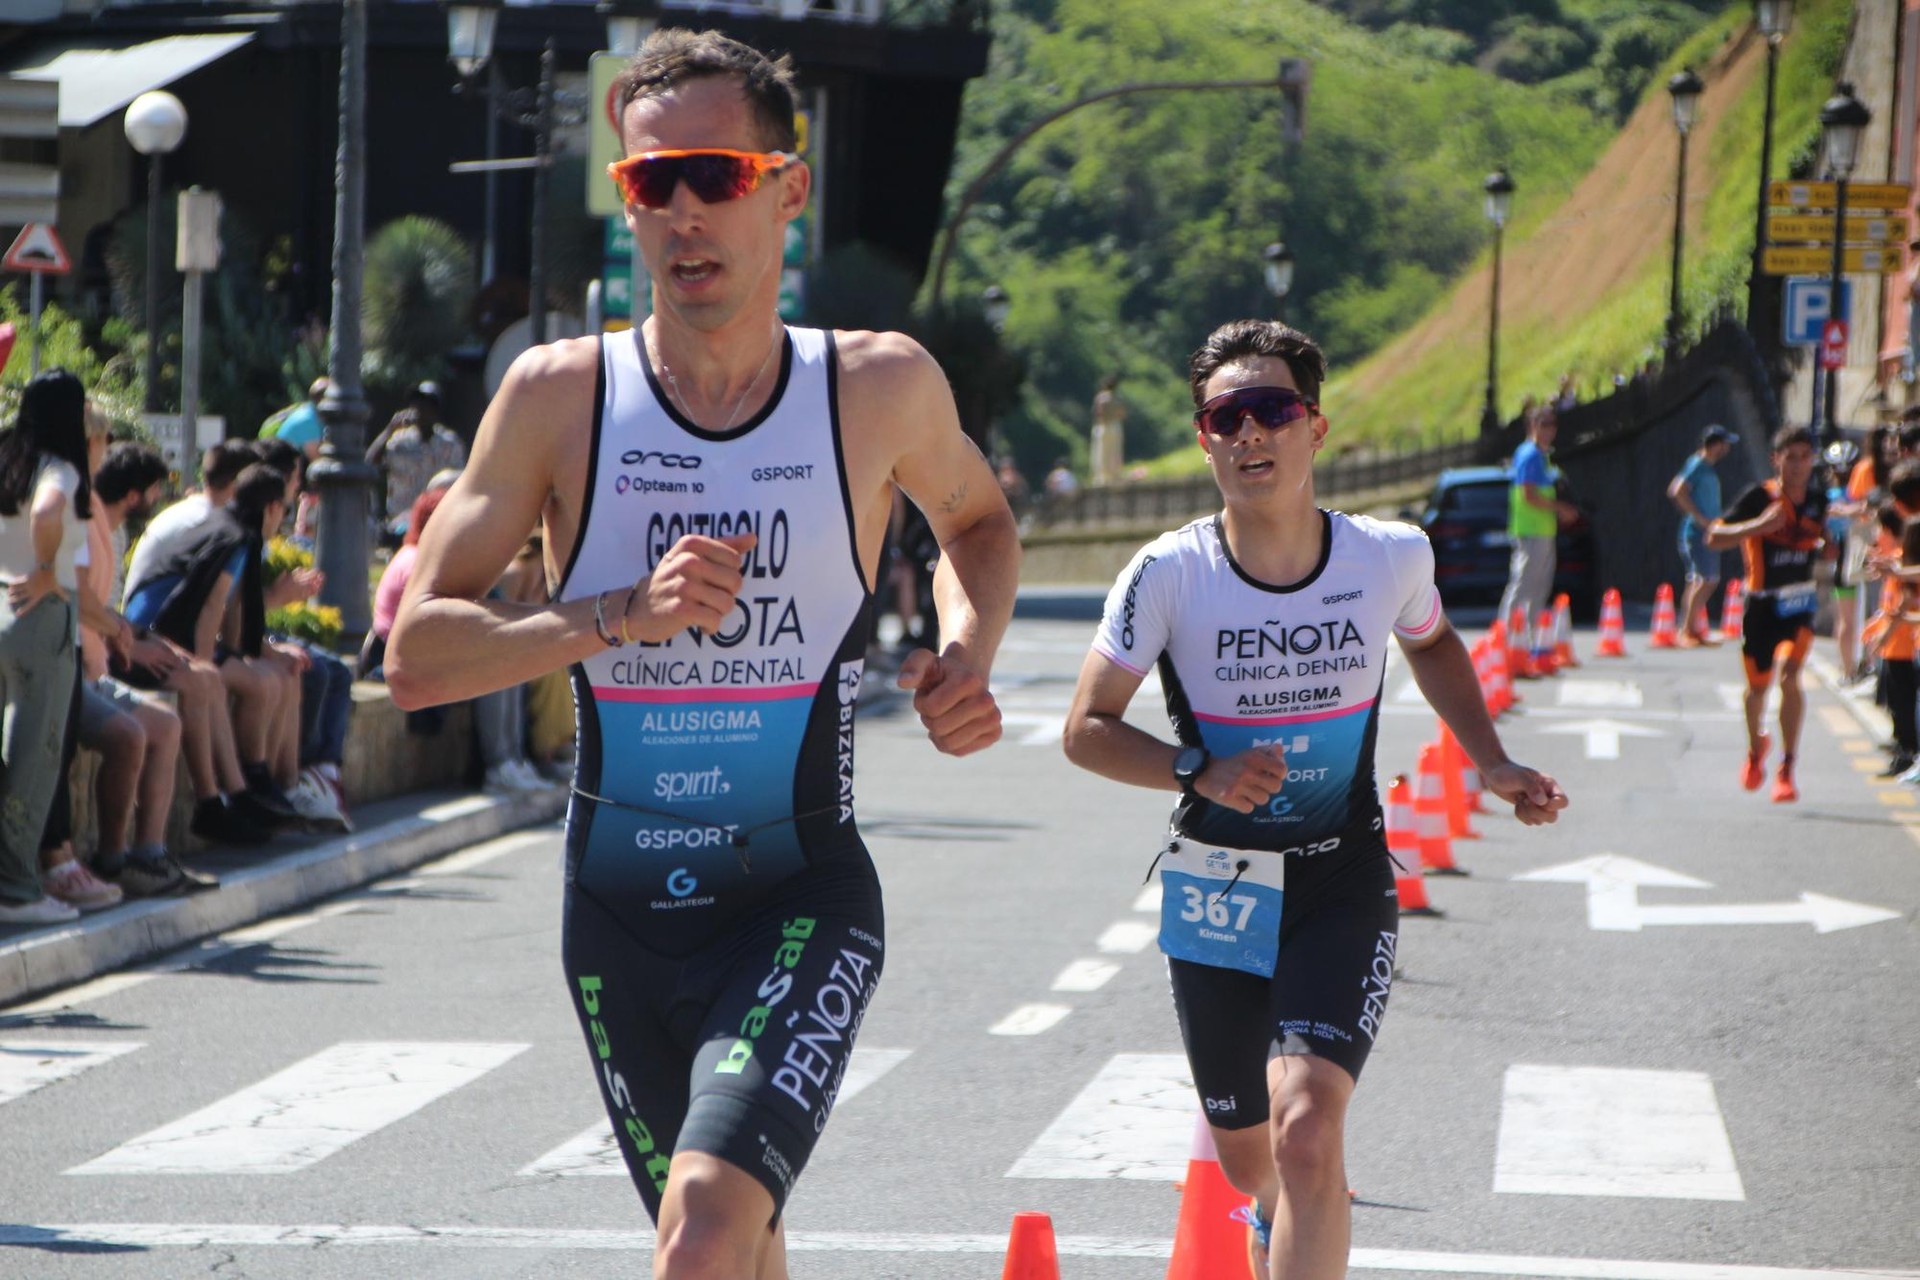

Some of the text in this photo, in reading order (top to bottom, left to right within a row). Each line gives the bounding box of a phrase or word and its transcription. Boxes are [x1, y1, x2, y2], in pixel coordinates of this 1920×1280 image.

[1795, 286, 1832, 336] P
[751, 465, 814, 481] GSPORT
[632, 477, 705, 495] Opteam 10
[1322, 590, 1364, 605] GSPORT
[1216, 618, 1365, 659] PEÑOTA
[611, 654, 806, 686] CLÍNICA DENTAL
[1215, 654, 1368, 682] CLÍNICA DENTAL
[1236, 685, 1342, 707] ALUSIGMA
[1290, 704, 1301, 712] DE
[641, 709, 763, 732] ALUSIGMA
[641, 732, 759, 745] ALEACIONES DE ALUMINIO
[838, 705, 853, 823] BIZKAIA
[1286, 767, 1329, 782] ORT
[636, 825, 740, 850] GSPORT
[650, 896, 716, 910] GALLASTEGUI
[1180, 885, 1258, 932] 367
[1199, 928, 1238, 943] Kirmen
[1358, 930, 1397, 1042] PEÑOTA
[771, 948, 872, 1112] PEÑOTA
